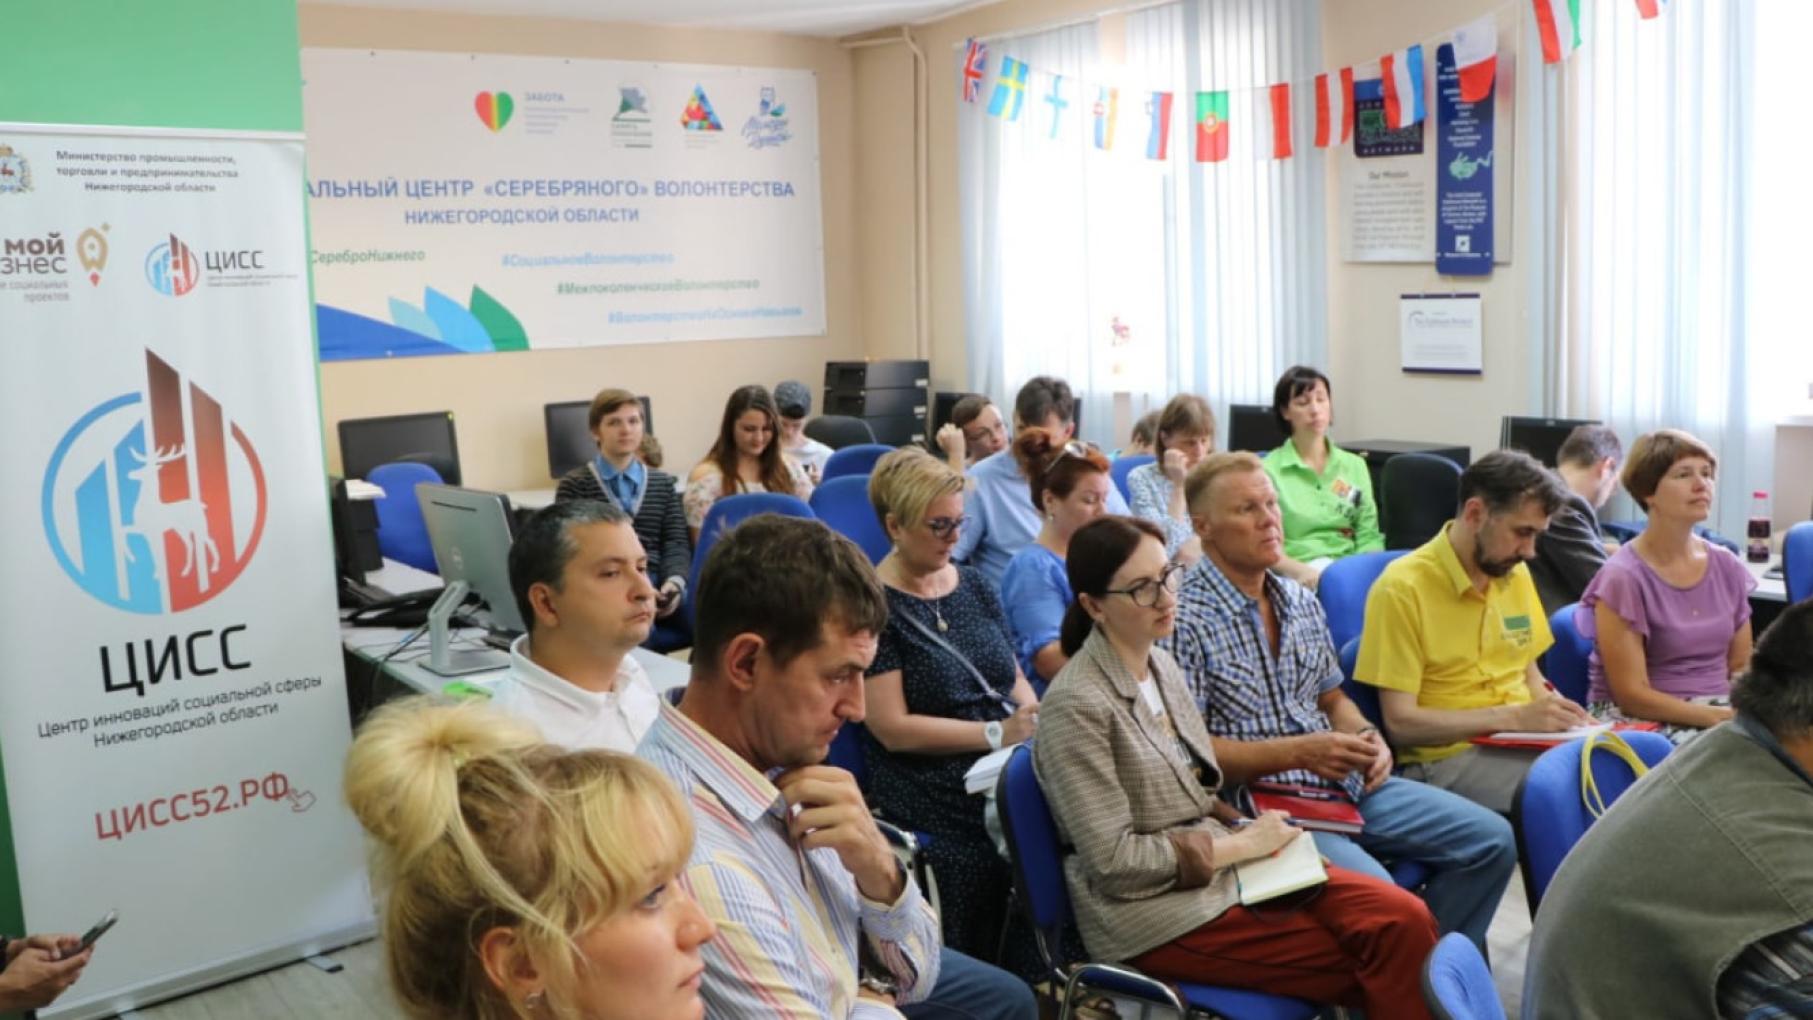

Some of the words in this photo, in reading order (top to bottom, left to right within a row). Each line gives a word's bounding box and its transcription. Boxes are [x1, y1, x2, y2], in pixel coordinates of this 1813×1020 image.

[56, 150, 137, 164] Министерство
[139, 152, 237, 166] промышленности,
[56, 167, 108, 179] торговли
[110, 168, 118, 177] и
[120, 168, 239, 180] предпринимательства
[84, 181, 172, 194] Нижегородской
[174, 182, 217, 193] области
[405, 179, 474, 200] ЦЕНТР
[484, 179, 648, 198] «СЕРЕБРЯНОГО»
[654, 180, 796, 198] ВОЛОНТЕРСТВА
[404, 206, 560, 225] НИЖЕГОРОДСКОЙ
[563, 207, 640, 224] ОБЛАСТИ
[205, 250, 265, 273] ЦИСС
[99, 623, 252, 697] ЦИСС
[37, 717, 90, 739] Центр
[93, 698, 181, 728] инноваций
[183, 682, 273, 711] социальной
[275, 675, 323, 695] сферы
[93, 711, 217, 748] Нижегородской
[219, 702, 280, 725] области
[94, 771, 290, 842] ЦИСС52.РФ
